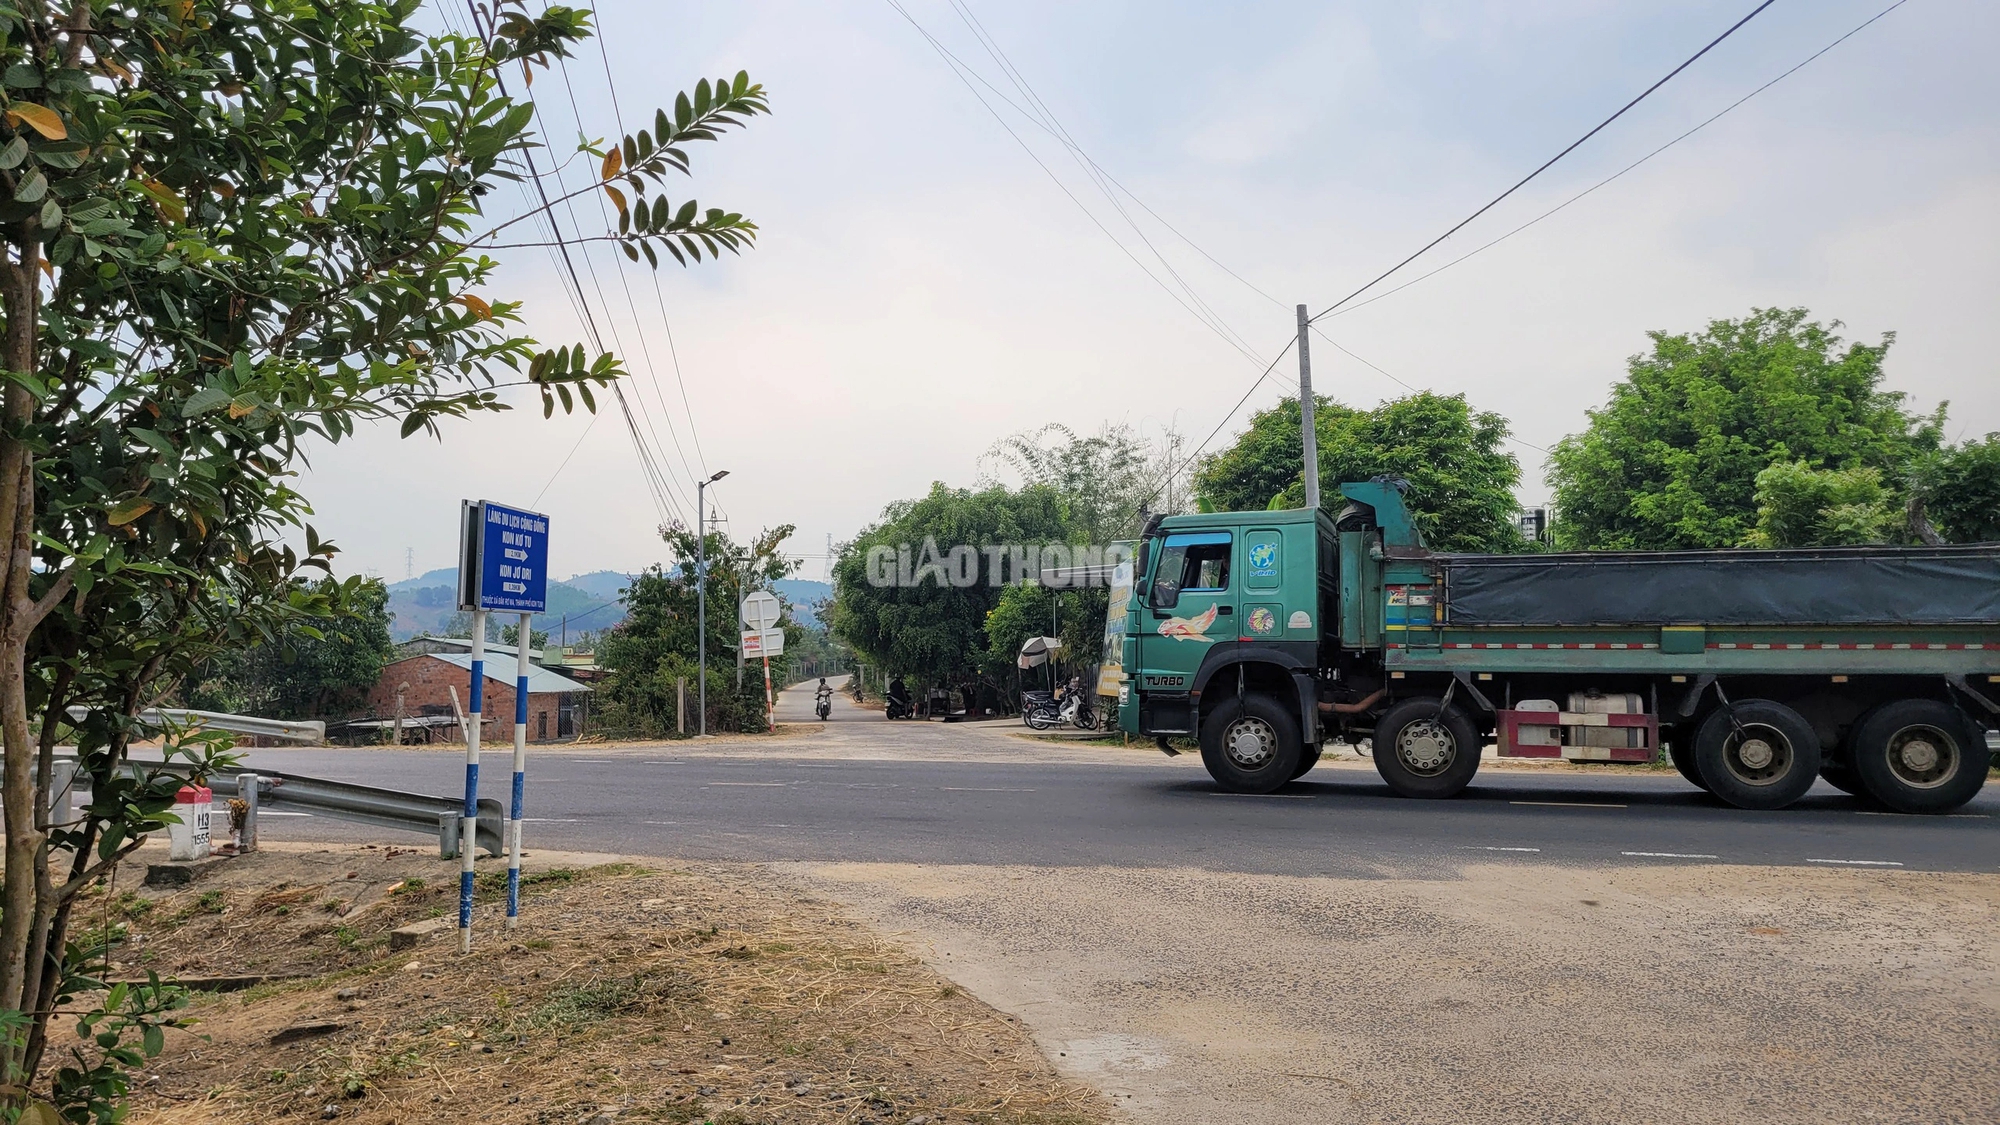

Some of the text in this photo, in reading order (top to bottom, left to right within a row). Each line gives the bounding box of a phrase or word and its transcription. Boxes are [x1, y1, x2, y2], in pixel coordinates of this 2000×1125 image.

[488, 508, 501, 524] LÀNG
[502, 513, 509, 526] DU
[509, 514, 520, 530] LỊCH
[520, 515, 533, 533] CỘNG
[502, 530, 515, 545] KON
[524, 536, 532, 548] TU
[499, 564, 512, 578] KON
[522, 567, 532, 581] DRI
[1145, 676, 1184, 686] TURBO
[198, 812, 210, 827] H3
[194, 832, 210, 846] 1555
